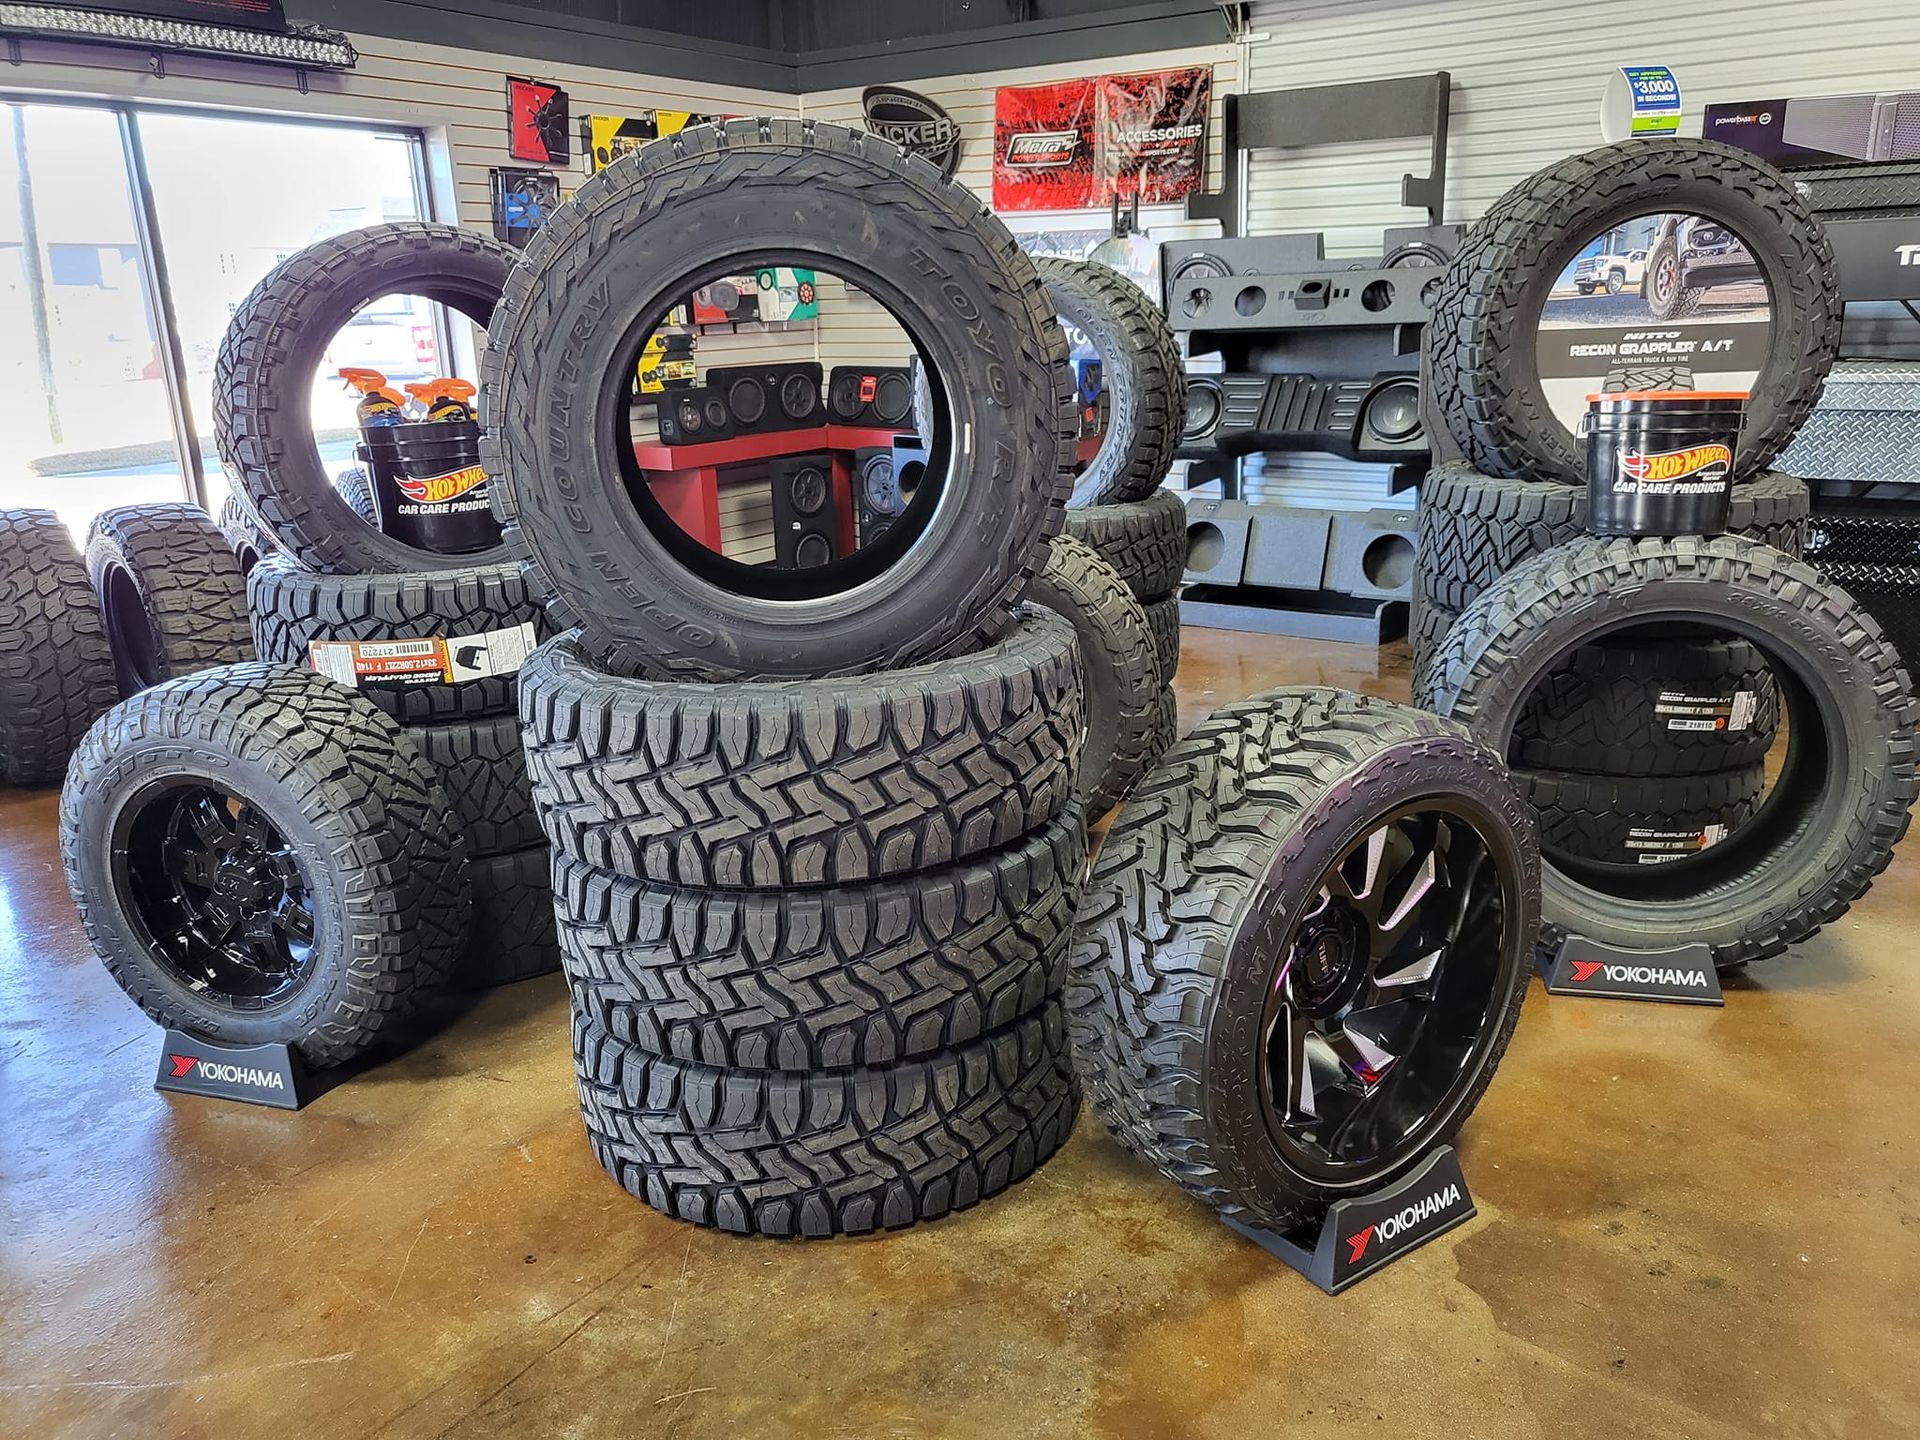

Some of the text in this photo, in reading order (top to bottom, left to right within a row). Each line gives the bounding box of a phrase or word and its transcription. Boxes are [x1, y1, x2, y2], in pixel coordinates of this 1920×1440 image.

[1633, 80, 1675, 95] $3,000
[873, 118, 953, 144] KICKER
[1116, 124, 1204, 144] ACCESSORIES
[909, 247, 1014, 408] TOYO
[1569, 339, 1734, 357] RECON GRAPPLER A/T
[1611, 356, 1643, 365] ALL-TERRAIN
[549, 275, 611, 534] COUNTRY
[1647, 453, 1685, 479] HOT
[424, 477, 460, 501] HOT
[1613, 481, 1726, 494] CAR CARE PRODUCTS
[398, 499, 490, 515] CAR CARE PRODUC
[585, 550, 717, 648] OPEN
[362, 648, 394, 657] 217270
[364, 670, 442, 682] RIDGE GRAPPLER
[376, 661, 382, 671] F
[1602, 964, 1708, 988] YOKOHAMA
[197, 1060, 285, 1091] YOKOHAMA
[1374, 1183, 1462, 1244] YOKOHAMA
